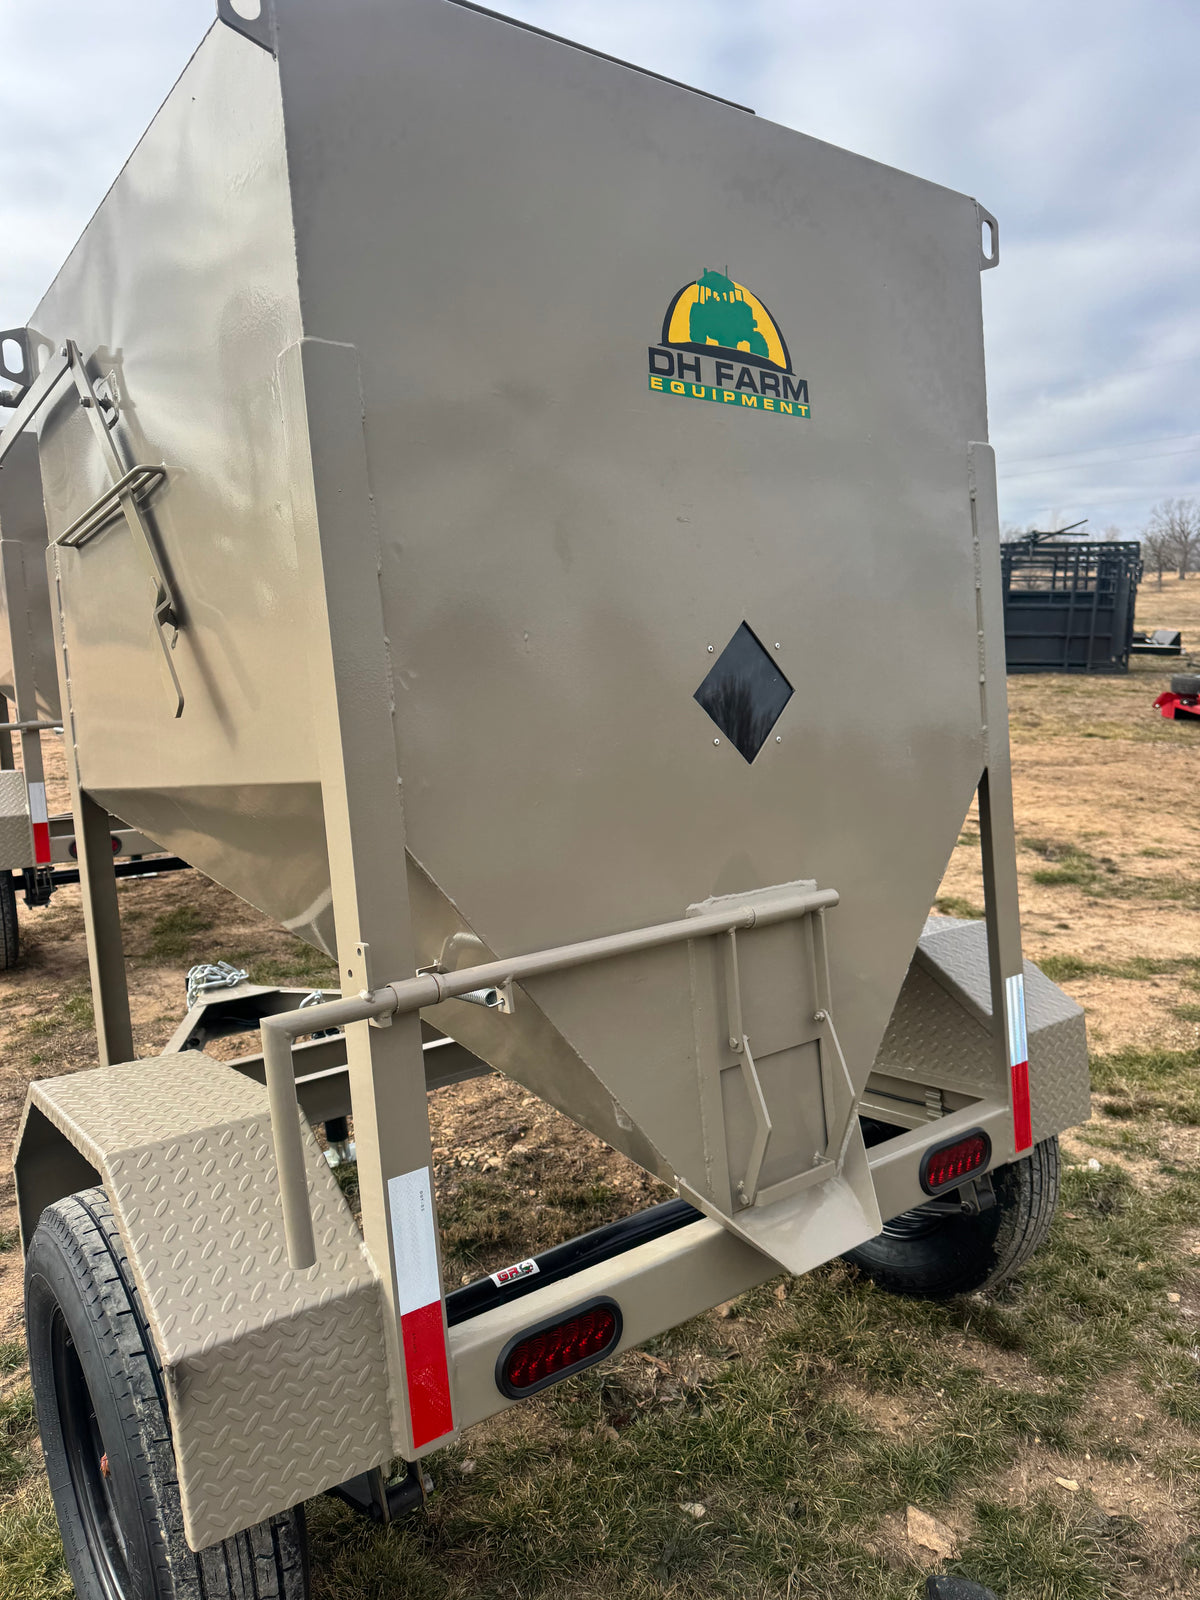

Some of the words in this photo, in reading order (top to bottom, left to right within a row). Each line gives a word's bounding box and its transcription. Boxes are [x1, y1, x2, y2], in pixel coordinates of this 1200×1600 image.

[648, 347, 701, 382] DH
[715, 361, 809, 403] FARM
[650, 377, 808, 416] EQUIPMENT
